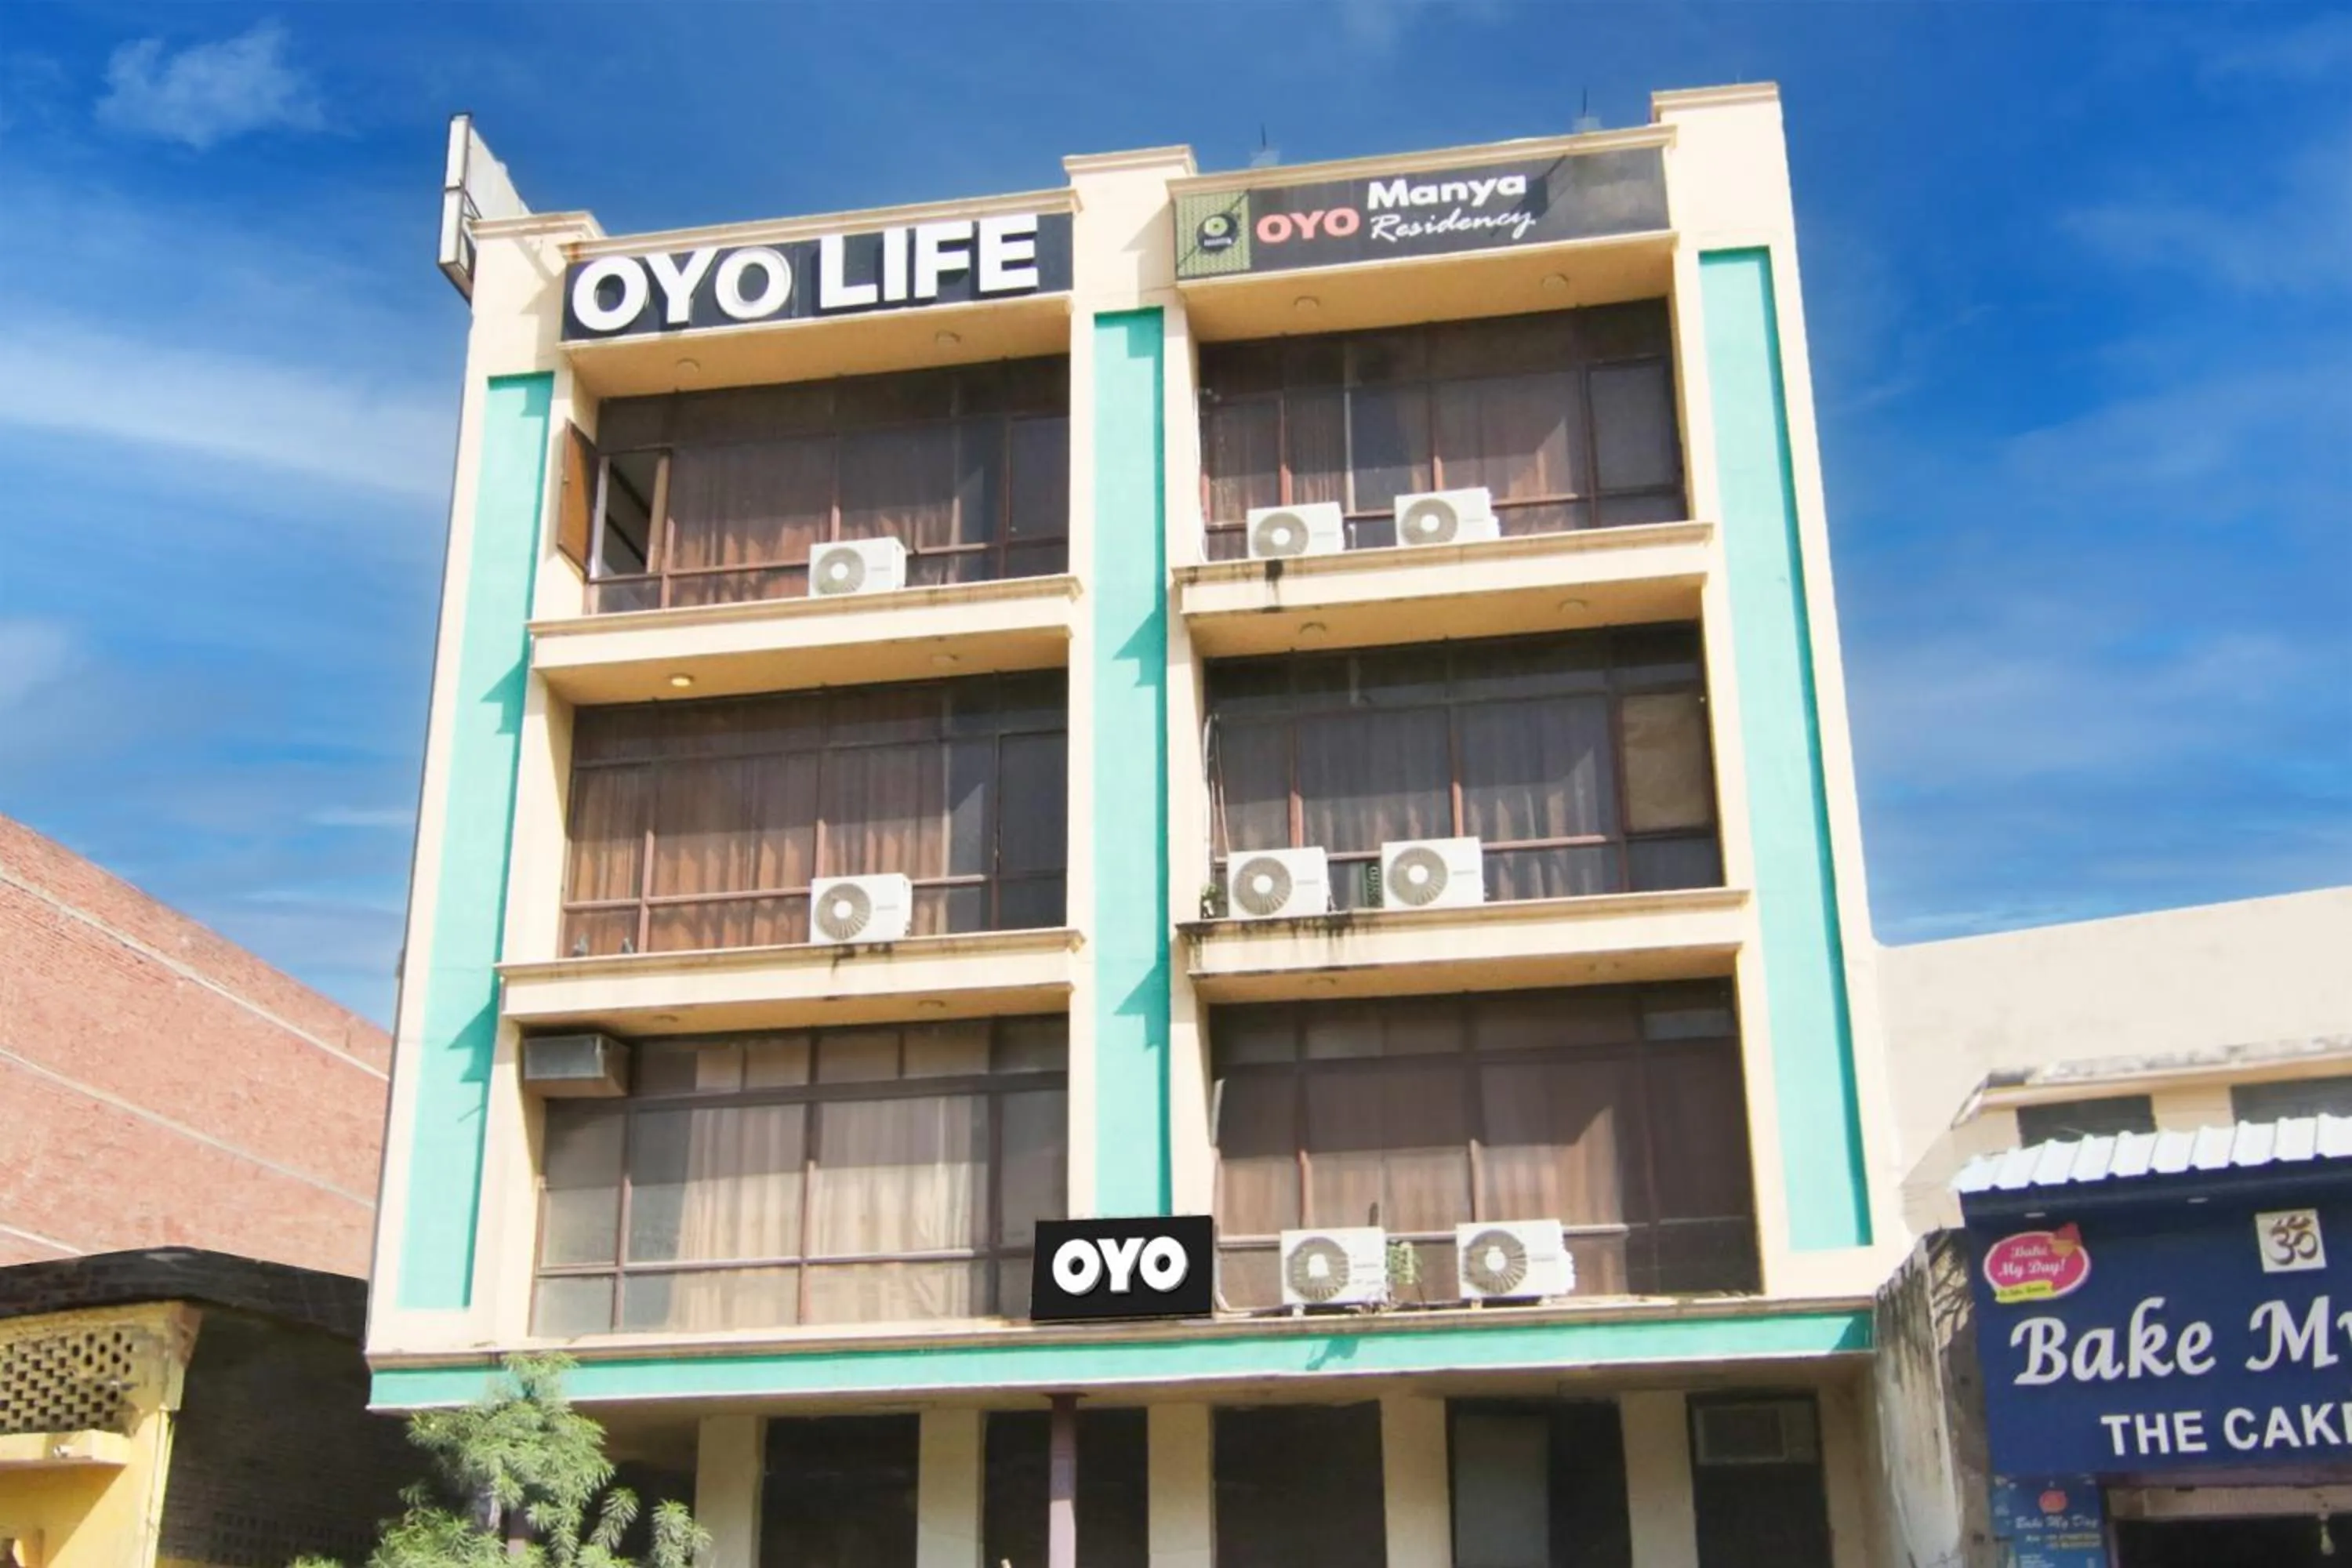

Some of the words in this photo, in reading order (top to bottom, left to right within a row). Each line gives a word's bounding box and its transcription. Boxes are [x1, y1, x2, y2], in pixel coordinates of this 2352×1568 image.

[1367, 173, 1527, 210] Manya
[1256, 207, 1360, 244] OYO
[1370, 207, 1537, 243] Residency
[572, 246, 793, 332] OYO
[819, 213, 1039, 309] LIFE
[1052, 1236, 1189, 1296] OYO
[2010, 1297, 2216, 1385] Bake
[2101, 1410, 2209, 1457] THE
